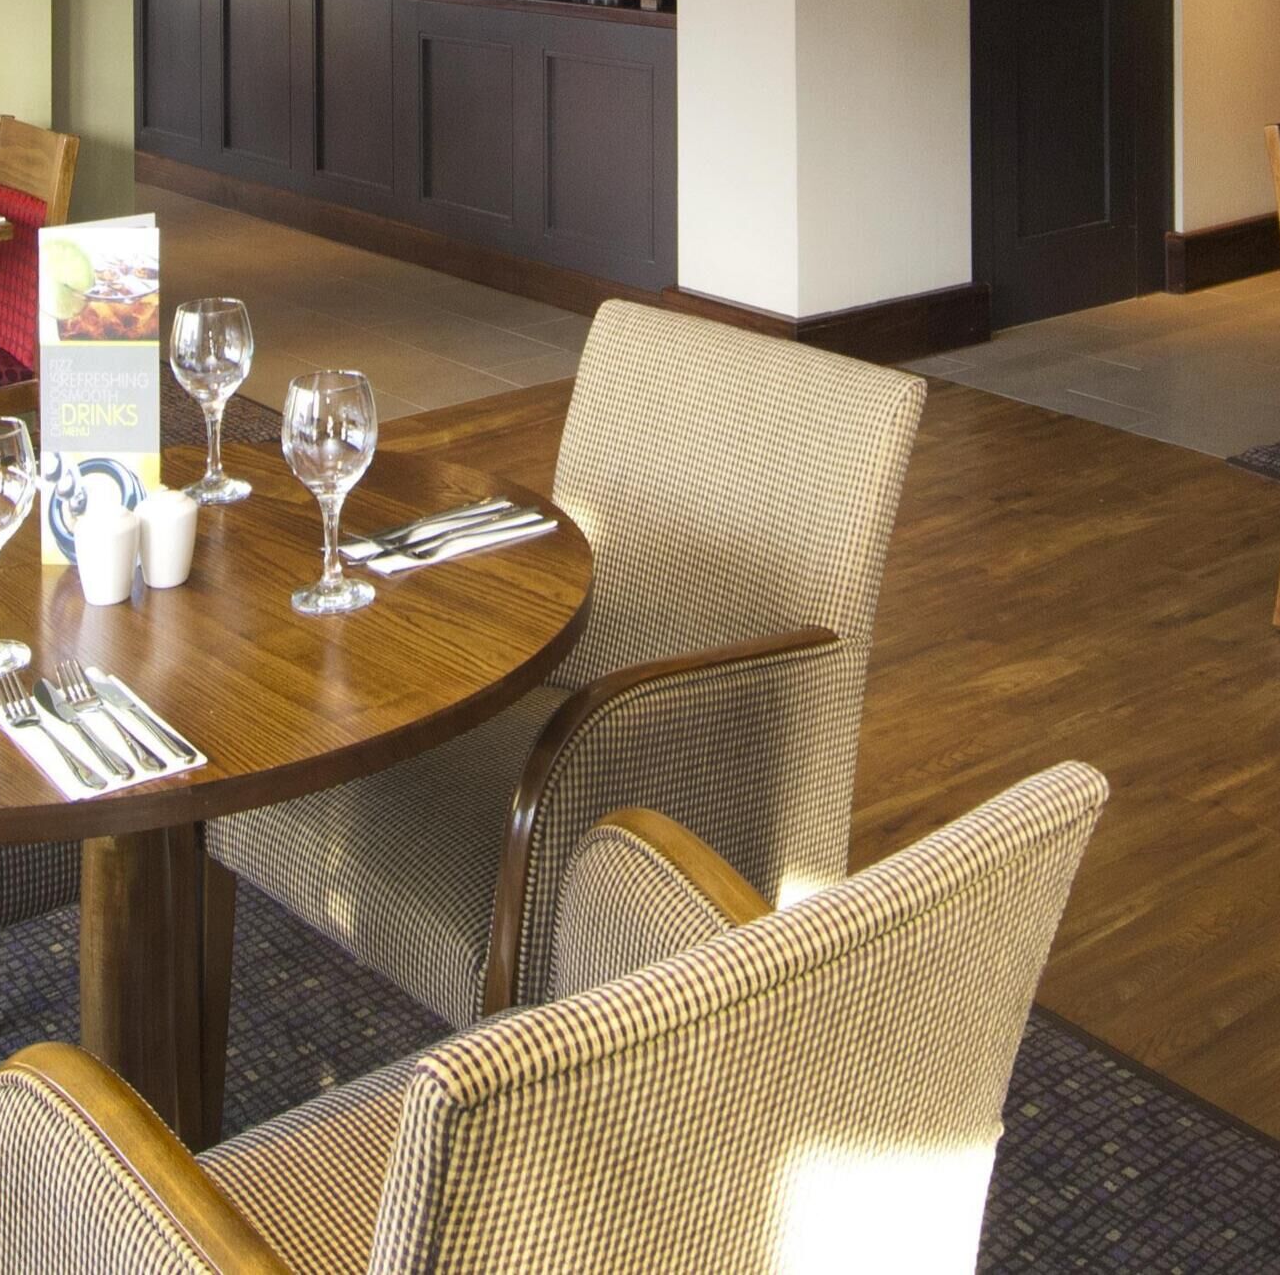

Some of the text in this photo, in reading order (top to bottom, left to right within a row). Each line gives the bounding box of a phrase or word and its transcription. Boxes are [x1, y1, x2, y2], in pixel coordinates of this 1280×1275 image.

[60, 372, 149, 388] REFRESHING
[61, 403, 139, 427] DRINKS
[62, 426, 90, 437] MENU
